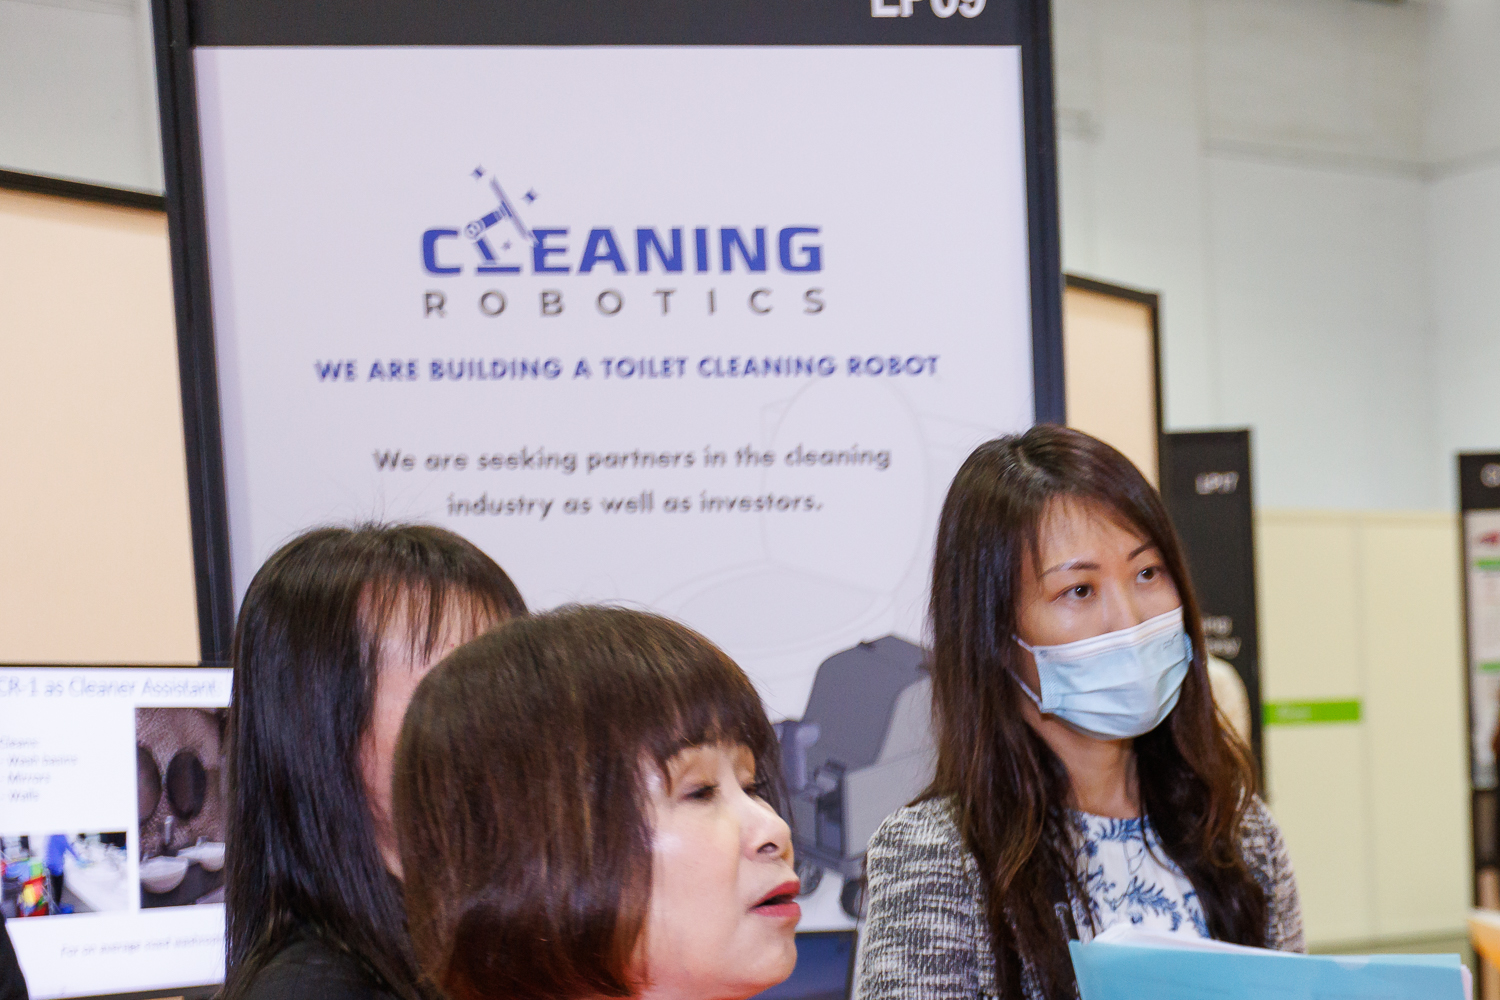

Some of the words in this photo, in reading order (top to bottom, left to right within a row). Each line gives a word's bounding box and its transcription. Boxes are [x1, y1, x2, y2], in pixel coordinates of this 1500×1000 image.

[422, 225, 824, 277] CLEANING
[423, 288, 826, 318] ROBOTICS
[315, 358, 358, 382] WE
[367, 358, 419, 382] ARE
[429, 357, 564, 381] BUILDING
[572, 357, 594, 380] A
[599, 356, 687, 379] TOILET
[697, 355, 837, 378] CLEANING
[846, 355, 941, 378] ROBOT
[373, 449, 416, 472] We
[424, 454, 468, 471] are
[476, 446, 579, 475] seeking
[586, 450, 696, 475] partners
[703, 445, 727, 468] in
[735, 443, 776, 469] the
[785, 443, 892, 471] cleaning
[446, 491, 553, 521] industry
[562, 497, 592, 514] as
[601, 490, 655, 514] well
[662, 497, 693, 513] as
[699, 490, 824, 513] investors.
[68, 675, 136, 698] Cleaner
